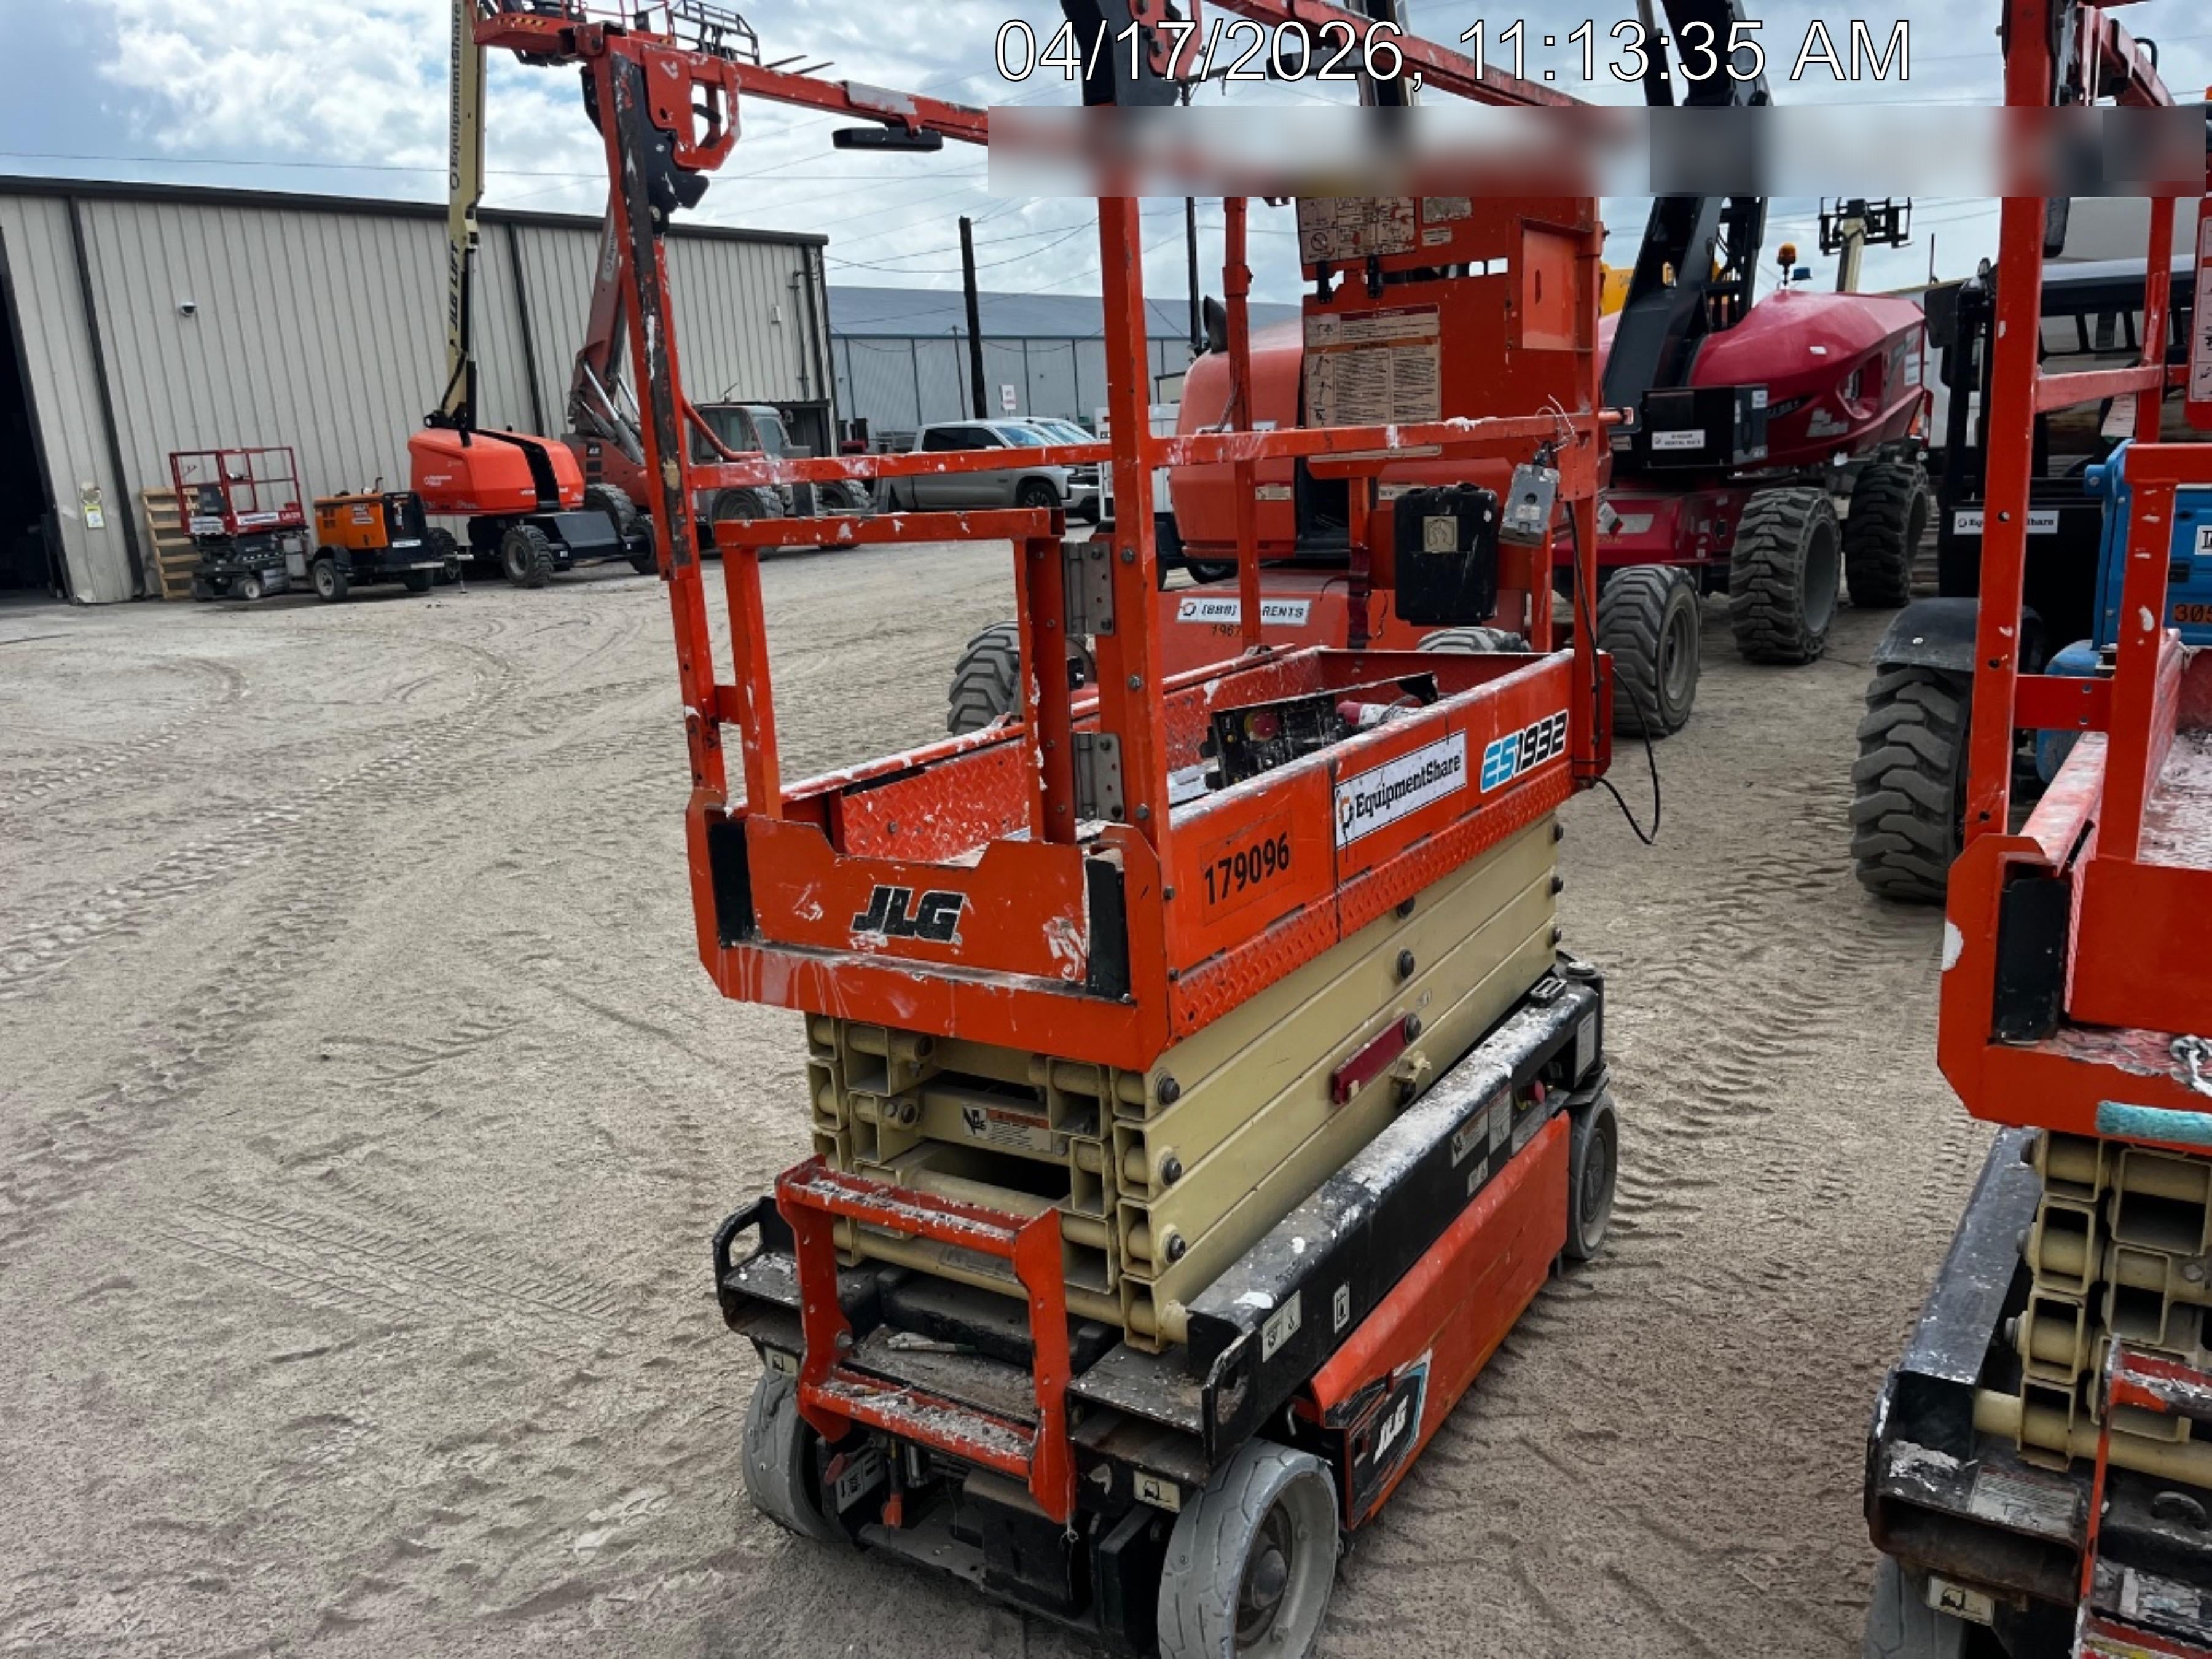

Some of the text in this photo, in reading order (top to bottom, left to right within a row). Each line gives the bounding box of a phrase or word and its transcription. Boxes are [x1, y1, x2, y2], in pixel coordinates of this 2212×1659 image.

[450, 4, 462, 168] EquipmentShare
[449, 239, 459, 332] JLG LIFT
[1355, 753, 1461, 819] EquipmentShare
[1480, 710, 1568, 793] ES1932
[1204, 833, 1291, 905] 179096
[850, 885, 966, 944] JLG
[1373, 1395, 1409, 1464] JLG
